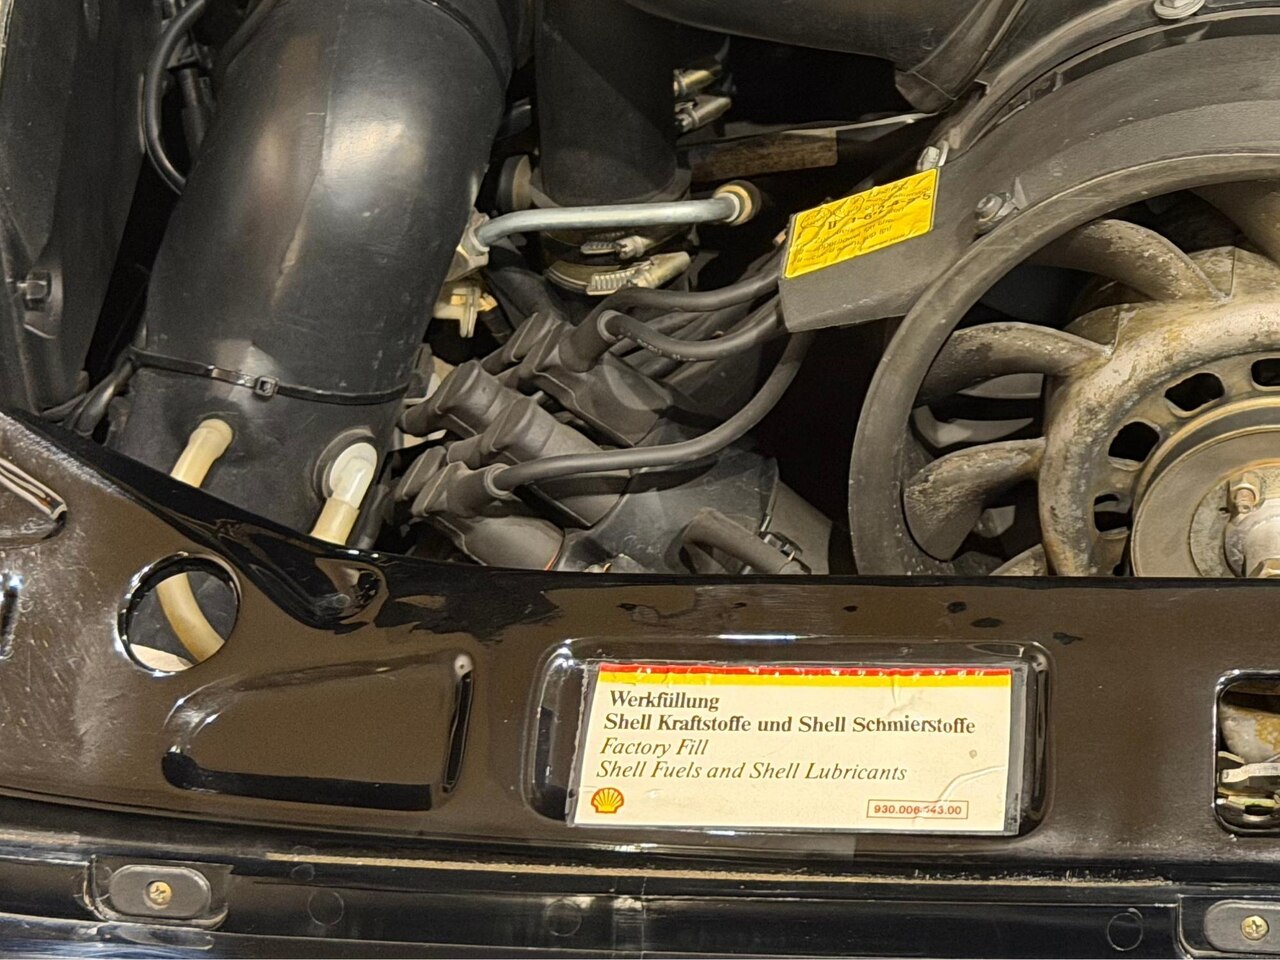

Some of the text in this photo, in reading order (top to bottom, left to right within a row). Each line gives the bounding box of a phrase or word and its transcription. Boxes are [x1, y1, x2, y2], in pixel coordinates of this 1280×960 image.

[610, 690, 720, 712] Werkfüllung
[604, 714, 975, 734] Shell Kraftstoffe und Shell Schmierstoffe
[600, 737, 708, 759] Factory Fill
[596, 761, 908, 782] Shell Fuels and Shell Lubricants
